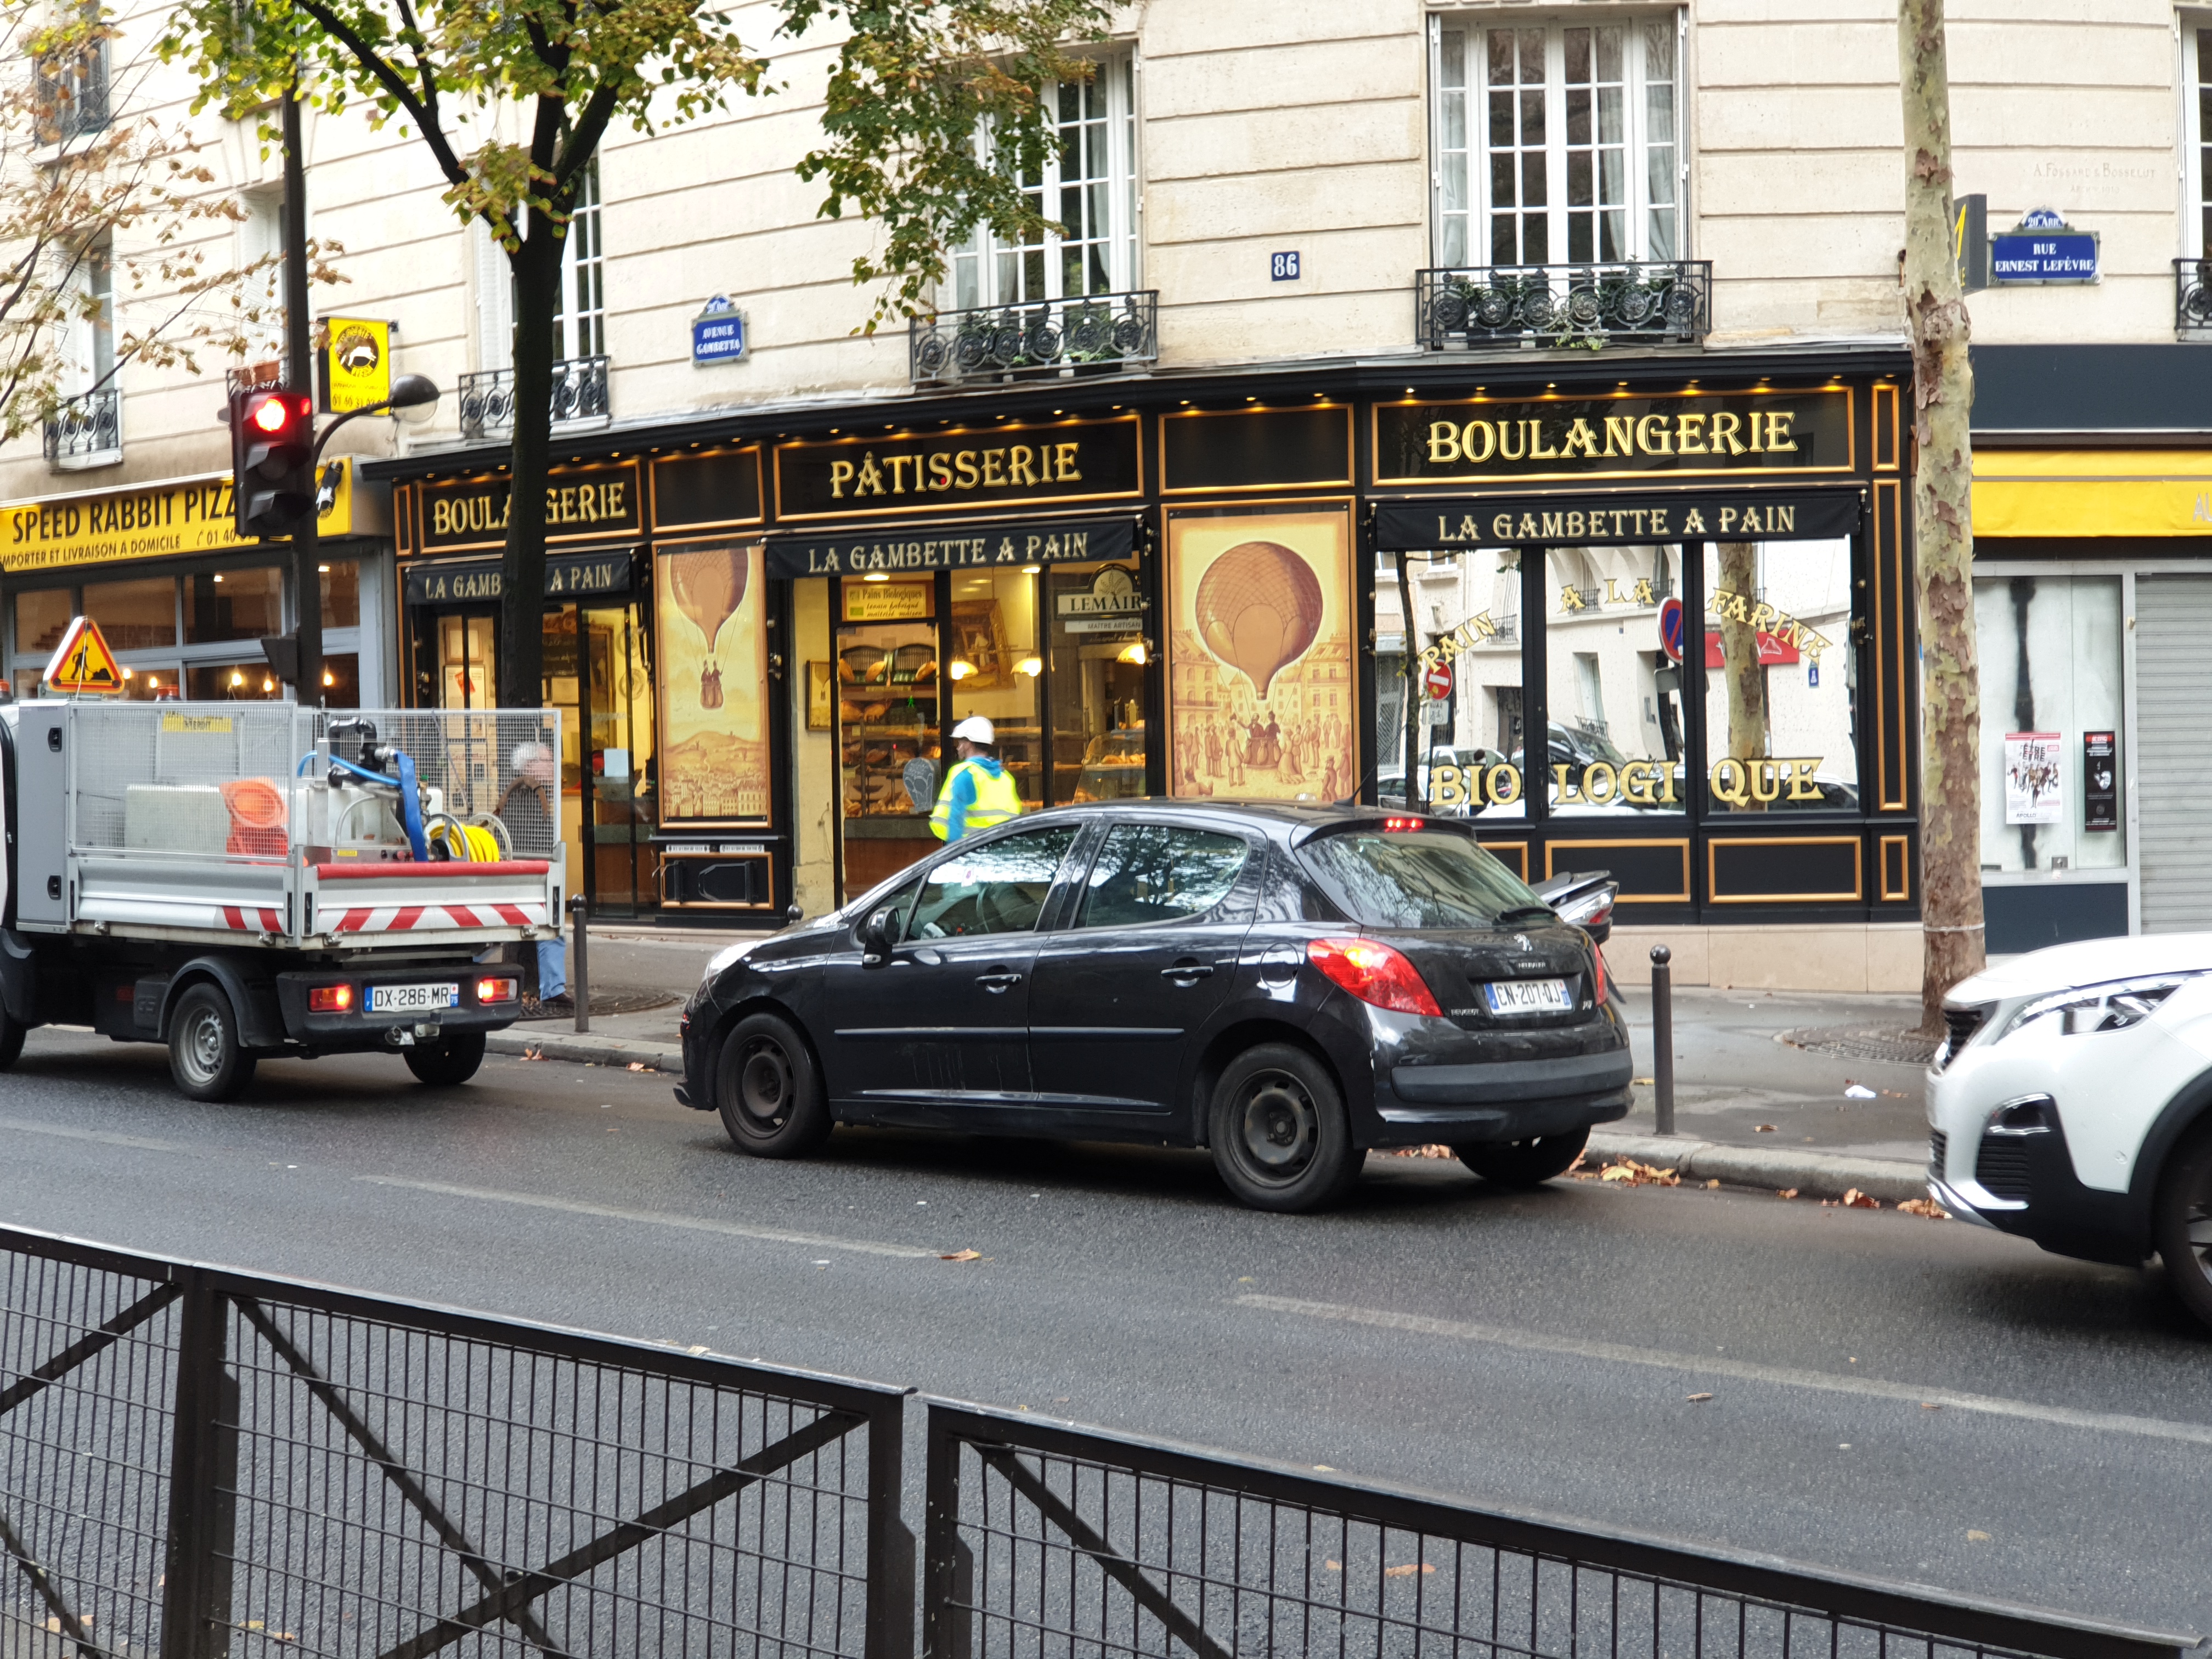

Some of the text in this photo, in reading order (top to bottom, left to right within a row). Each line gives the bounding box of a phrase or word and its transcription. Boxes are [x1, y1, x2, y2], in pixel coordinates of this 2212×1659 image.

[1274, 253, 1297, 277] 86
[1995, 260, 2039, 272] ERNEST
[2033, 243, 2056, 255] RUE
[696, 338, 741, 355] GAMBETTA
[702, 324, 735, 340] AVENUE
[1426, 411, 1799, 463] BOULANGERIE
[829, 442, 1084, 499] PÂTISSERIE
[13, 486, 236, 544] SPEED RABBIT PIZZ
[1437, 505, 1796, 541] LA GAMBETTE A PAIN
[0, 550, 46, 568] MPORTER
[50, 549, 60, 564] ET
[63, 540, 117, 562] LIVRAISON
[120, 540, 127, 556] A
[131, 533, 181, 554] DOMICILE
[206, 529, 218, 546] 01
[808, 532, 1089, 574] LA GAMBETTE A PAIN
[425, 577, 447, 600] LA
[550, 568, 563, 592] A
[570, 563, 612, 591] PAIN
[1070, 595, 1142, 612] LEMAIR
[1418, 578, 1833, 674] PAIN A LA FARINE
[1429, 757, 1826, 808] BIO LOGI QUE
[375, 987, 449, 1007] DX-286-MR
